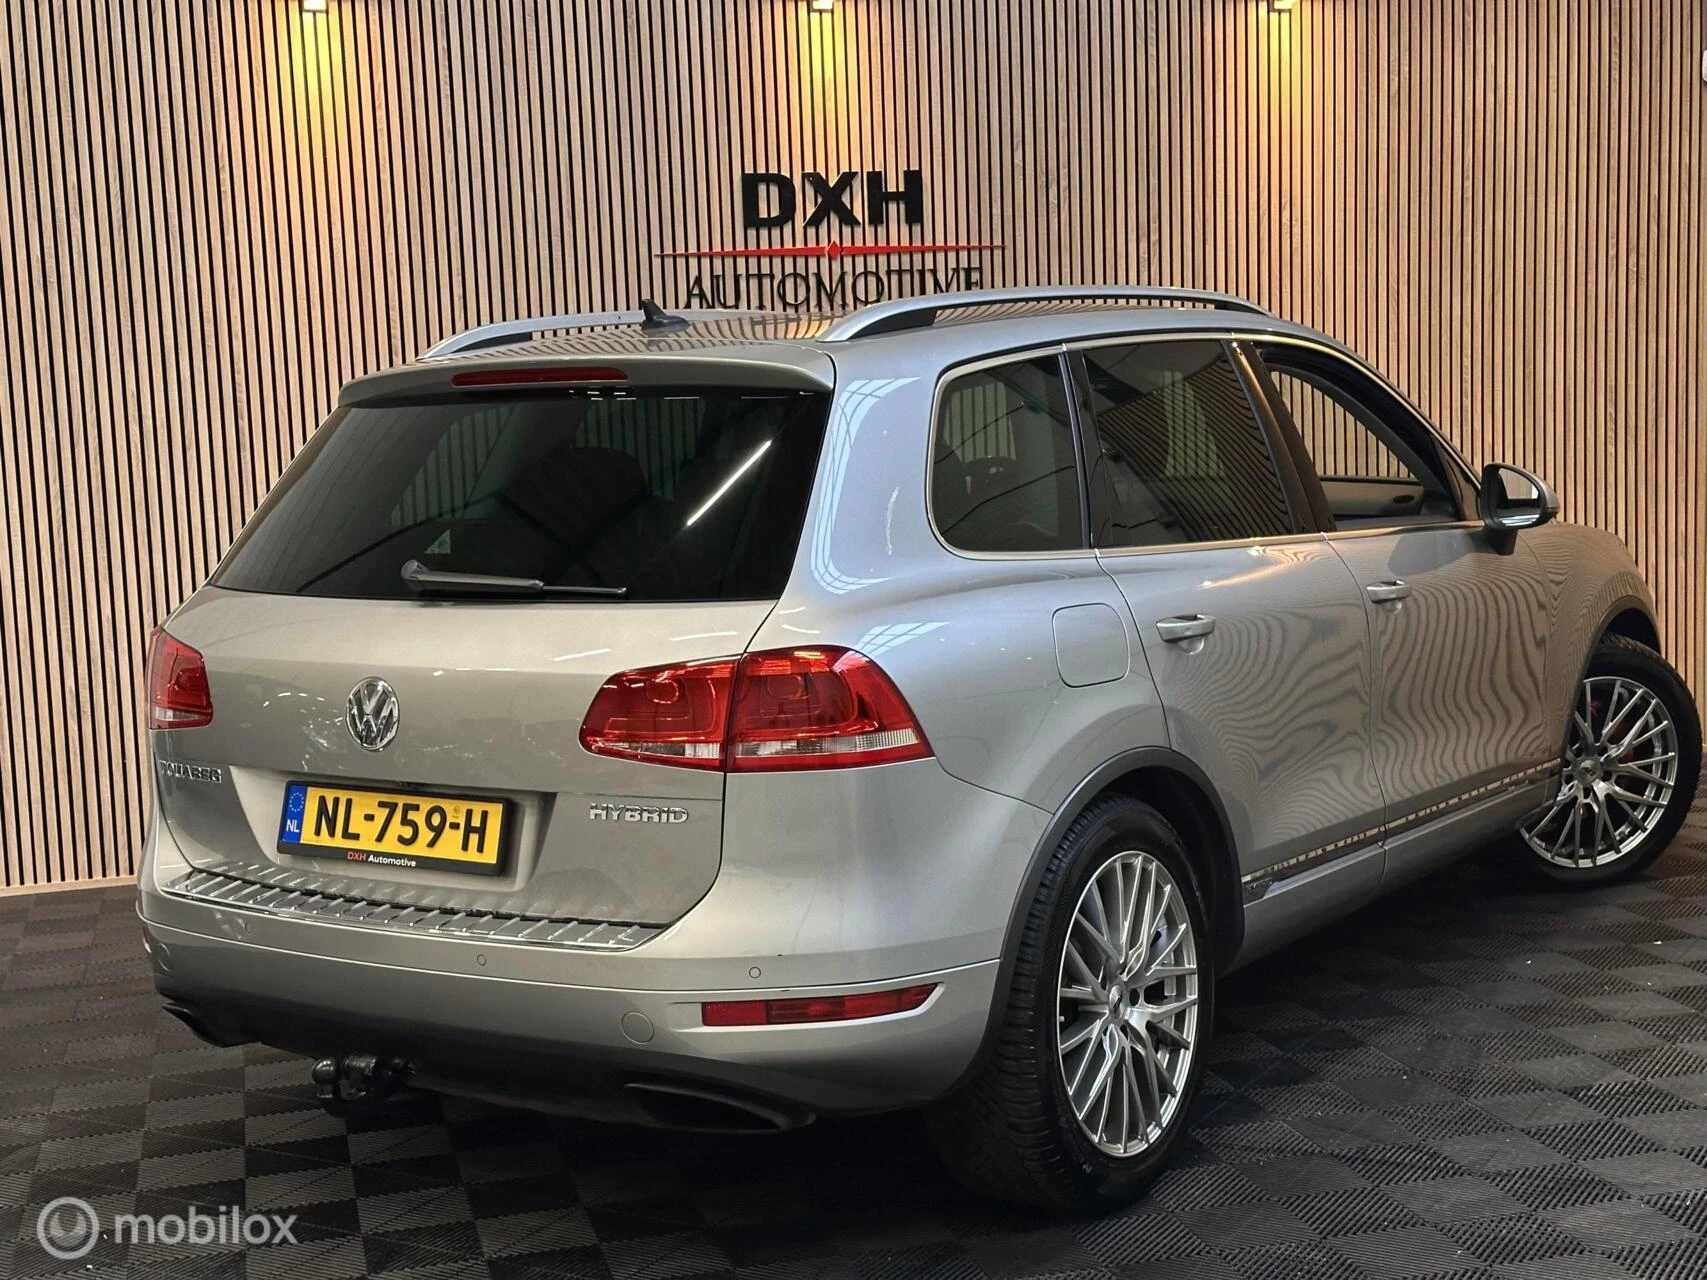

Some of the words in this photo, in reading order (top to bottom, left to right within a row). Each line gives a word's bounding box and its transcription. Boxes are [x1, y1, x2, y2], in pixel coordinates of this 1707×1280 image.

[742, 169, 923, 228] DXH
[683, 266, 984, 310] AUTOMOTIVE
[159, 759, 222, 784] TOUAREG
[286, 818, 300, 833] NL
[314, 795, 489, 853] NL-759-H
[589, 802, 689, 824] HYBRID
[347, 851, 367, 861] DXH
[367, 854, 417, 867] Automotive
